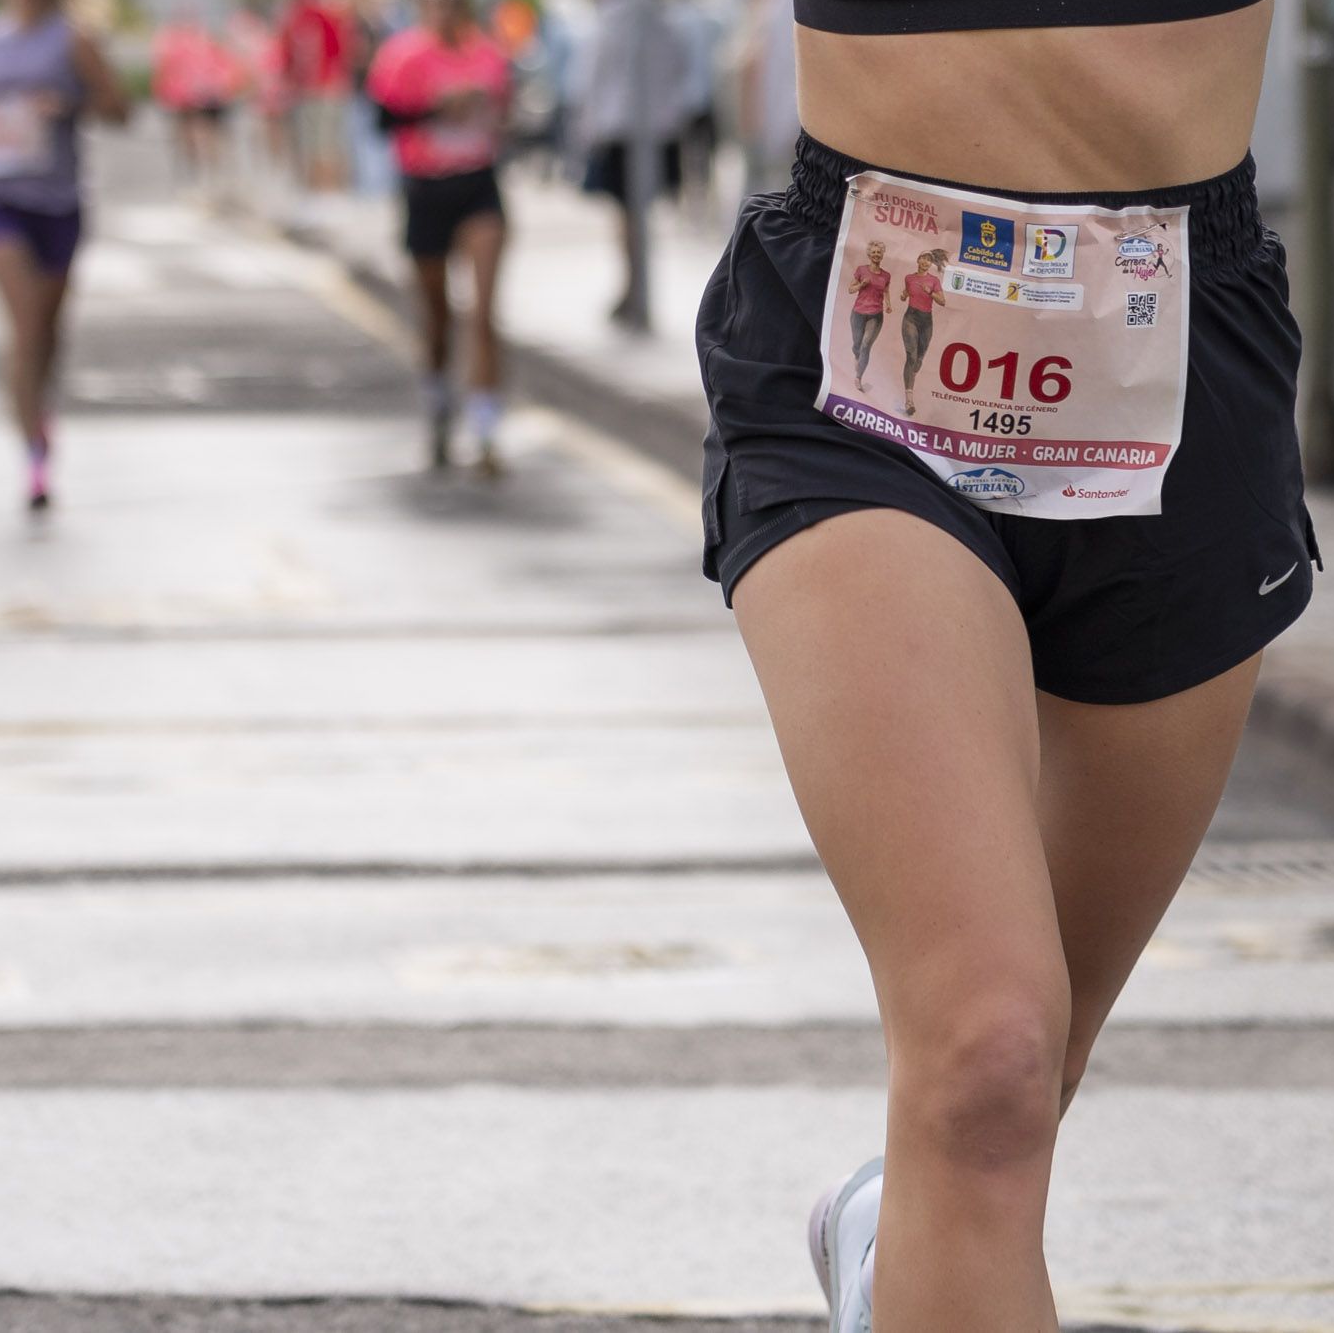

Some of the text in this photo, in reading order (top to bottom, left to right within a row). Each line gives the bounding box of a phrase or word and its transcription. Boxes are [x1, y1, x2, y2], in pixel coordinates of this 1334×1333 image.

[874, 192, 938, 217] TU DORSAL
[874, 206, 939, 235] SUMA
[964, 252, 1008, 267] Gran Canaria
[968, 246, 994, 257] Cabildo
[1115, 256, 1147, 266] Carrera
[939, 342, 1073, 404] 016
[931, 391, 970, 404] TELÉFONO
[971, 399, 1013, 411] VIOLENCIA
[1025, 405, 1058, 413] GÉNERO
[969, 409, 1032, 435] 1495
[832, 404, 1156, 464] CARRERA DE LA MUJER GRAN CANARIA
[953, 478, 1019, 494] ASTURIANA
[1077, 488, 1130, 499] Santander
